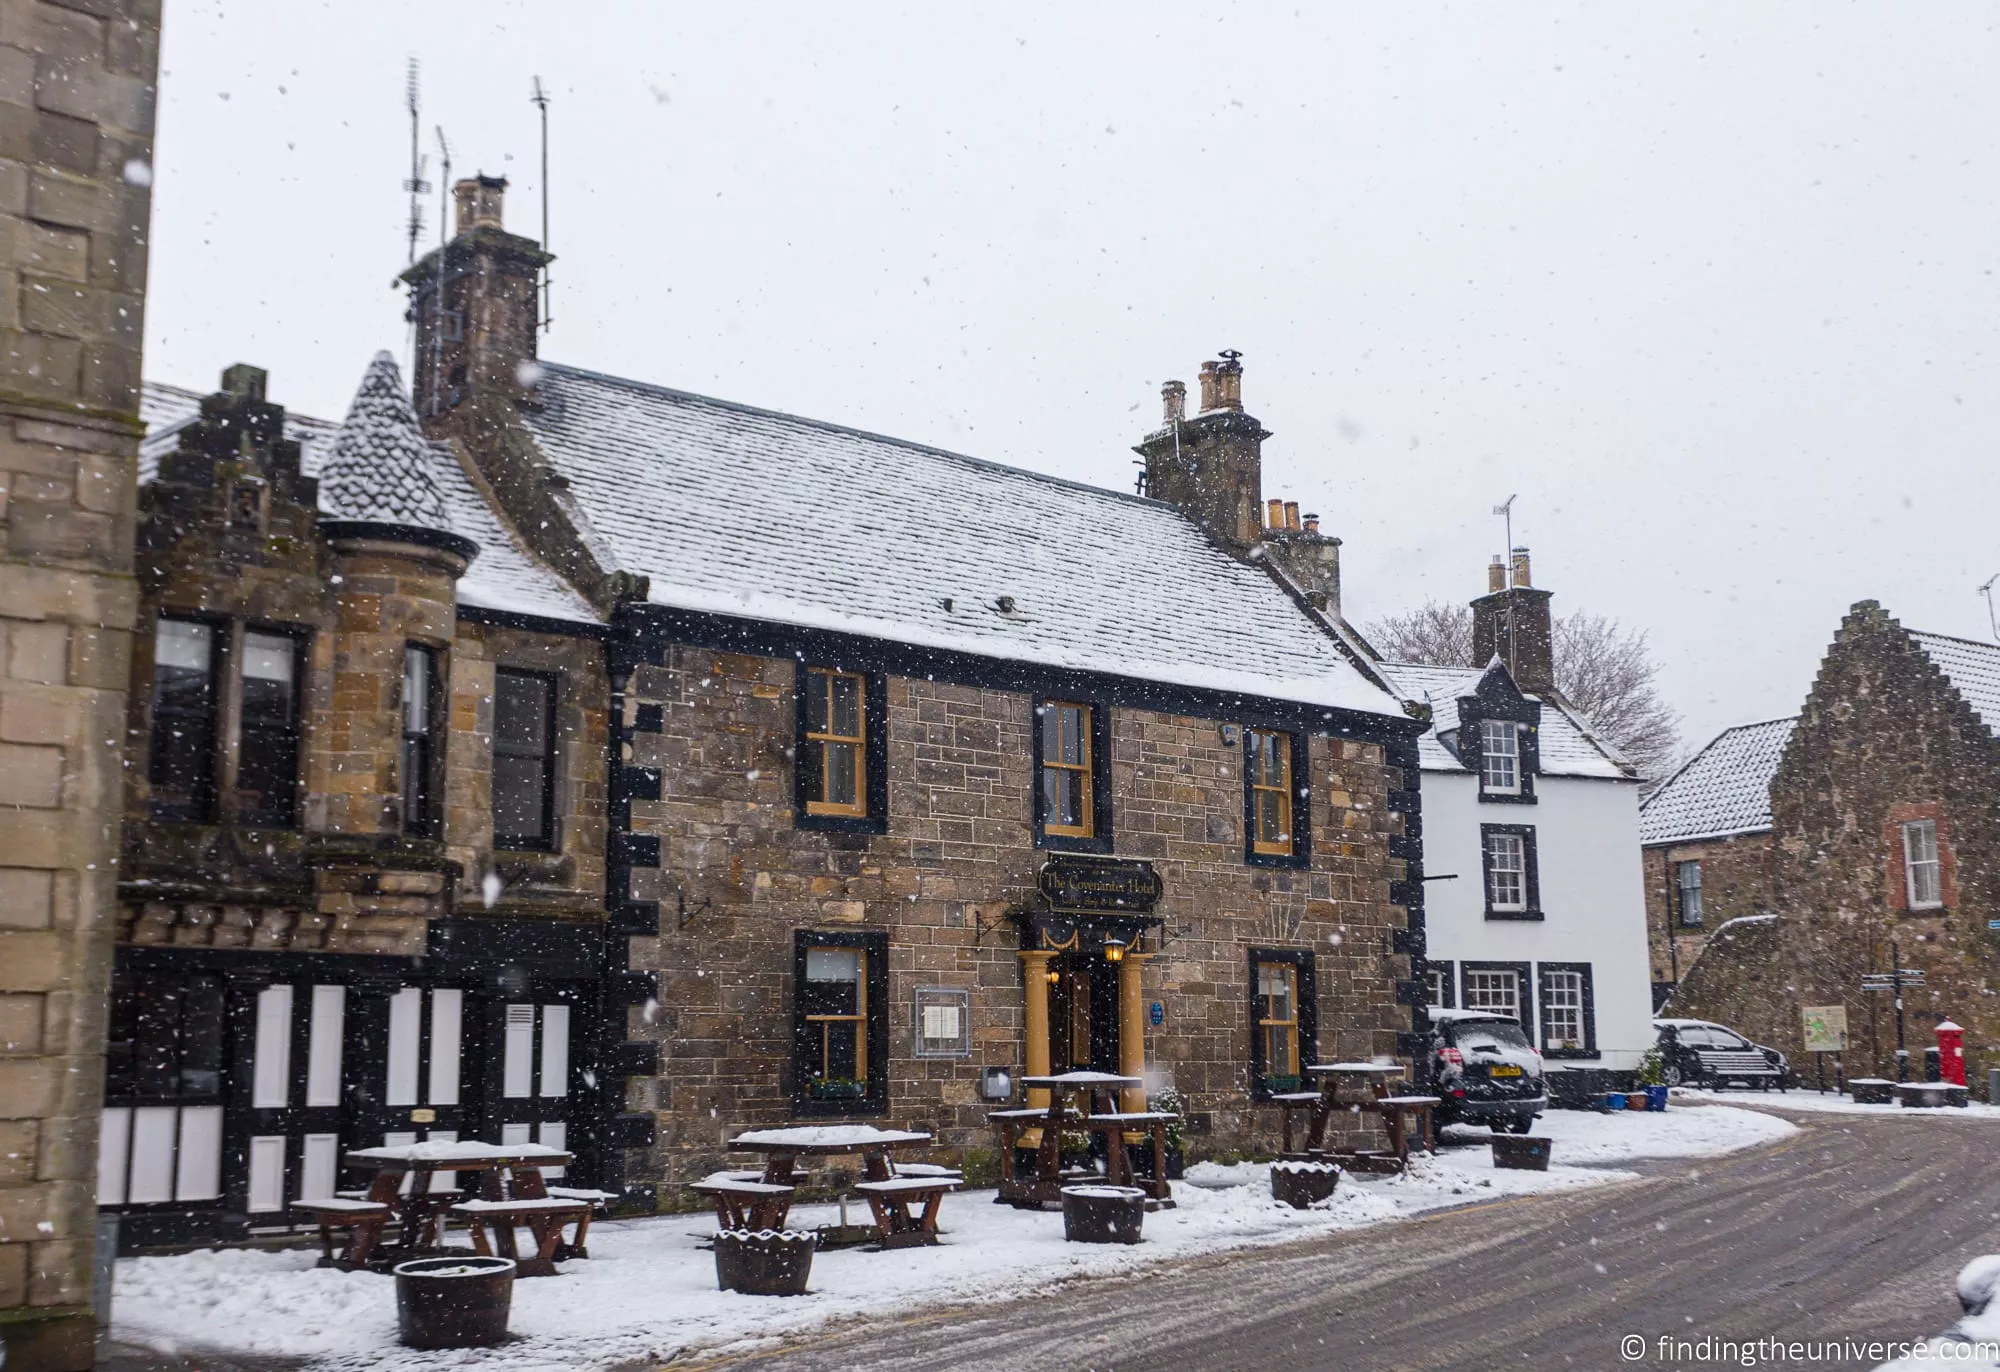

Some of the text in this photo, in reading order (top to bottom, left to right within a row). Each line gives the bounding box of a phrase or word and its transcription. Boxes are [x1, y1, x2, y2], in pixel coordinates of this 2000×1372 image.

[1045, 871, 1155, 894] The Covenanter Hotel
